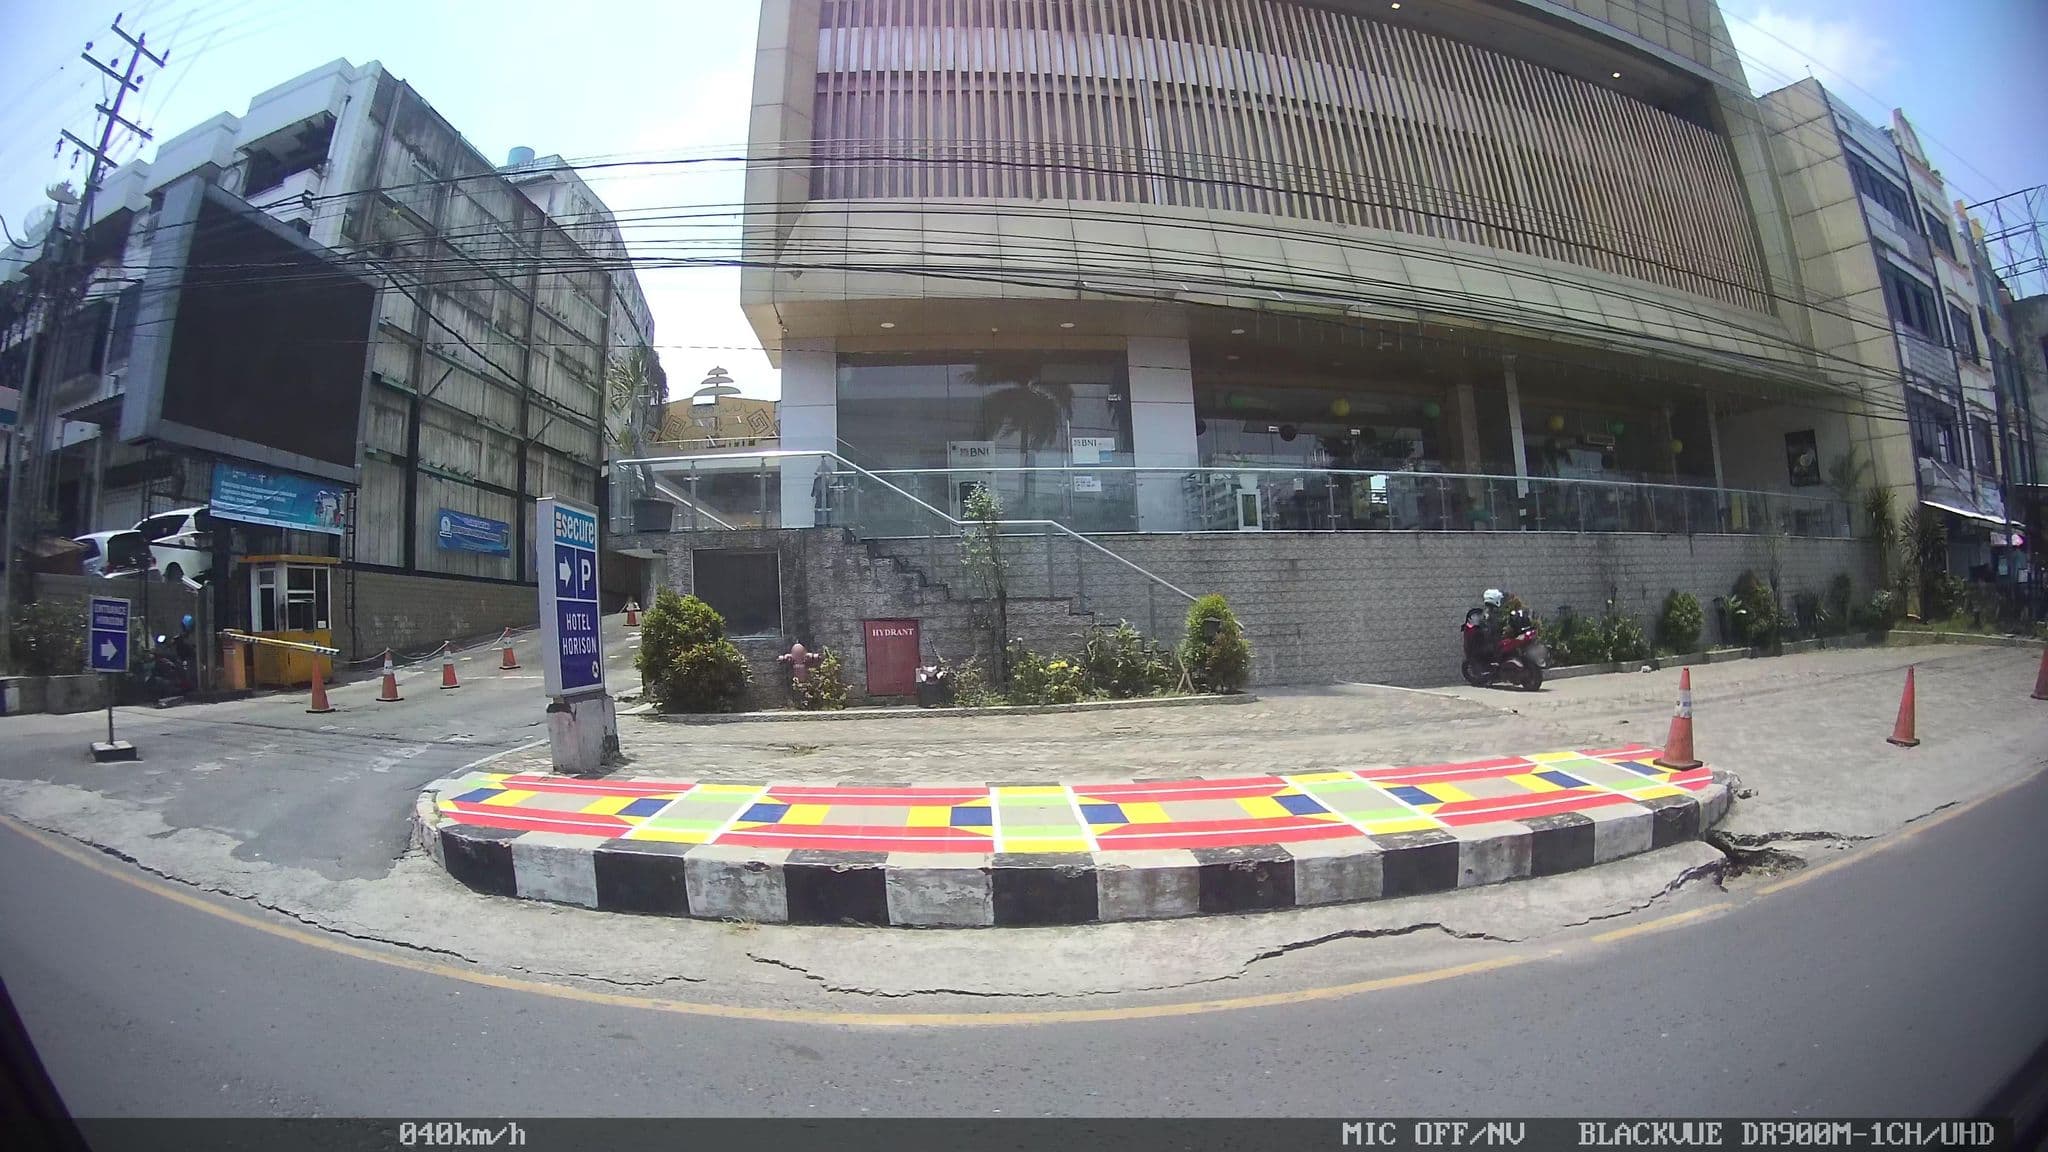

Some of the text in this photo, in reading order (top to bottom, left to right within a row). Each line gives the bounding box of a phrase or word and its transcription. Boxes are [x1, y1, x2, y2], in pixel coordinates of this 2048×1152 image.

[970, 447, 989, 457] BNI
[1081, 439, 1097, 447] BNI
[560, 513, 594, 544] secure
[581, 558, 591, 592] P
[566, 613, 591, 631] HOTEL
[872, 628, 914, 637] HYDRANT
[562, 636, 597, 655] HORISON
